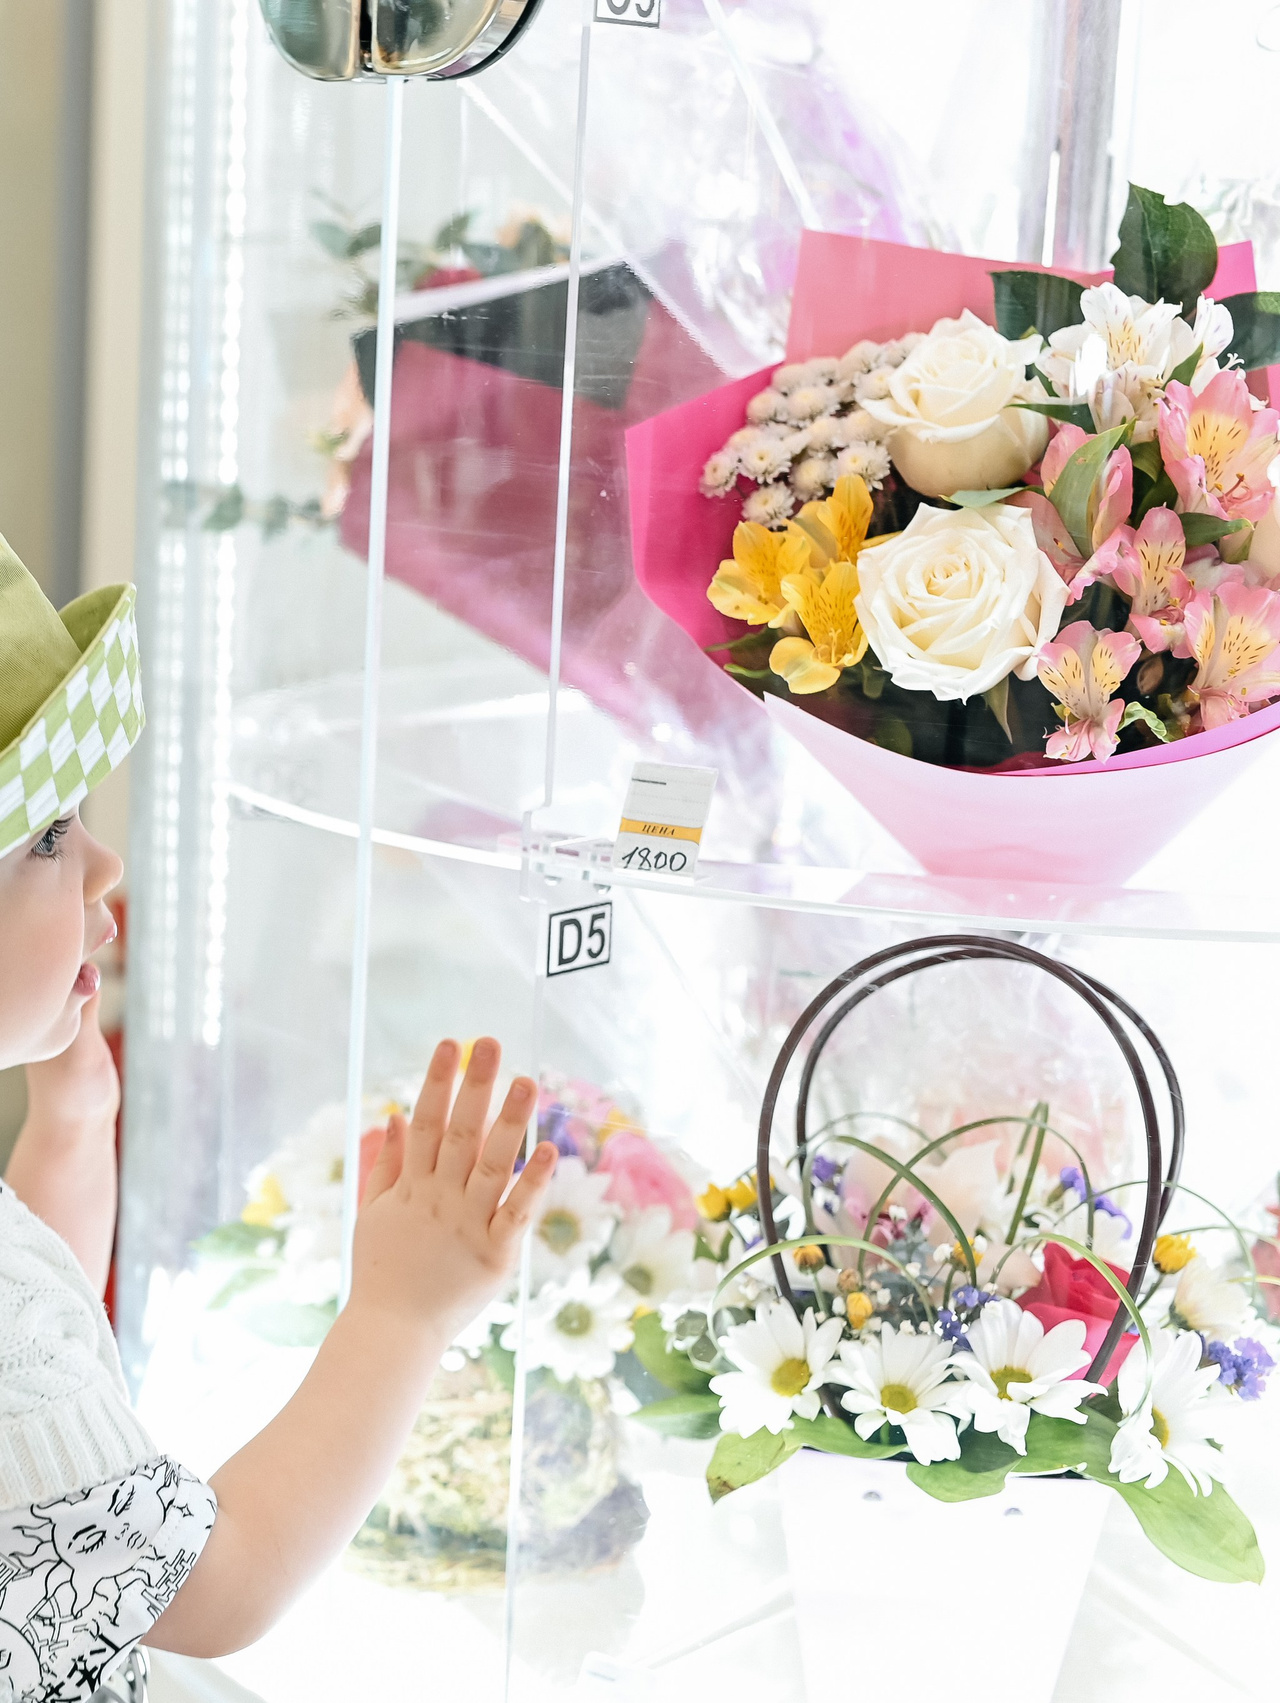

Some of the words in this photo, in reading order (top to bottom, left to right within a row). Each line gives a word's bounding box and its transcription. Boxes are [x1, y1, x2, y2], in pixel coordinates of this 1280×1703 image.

[642, 824, 675, 836] ЦЕНА
[621, 846, 687, 872] 1800
[558, 912, 605, 966] D5
